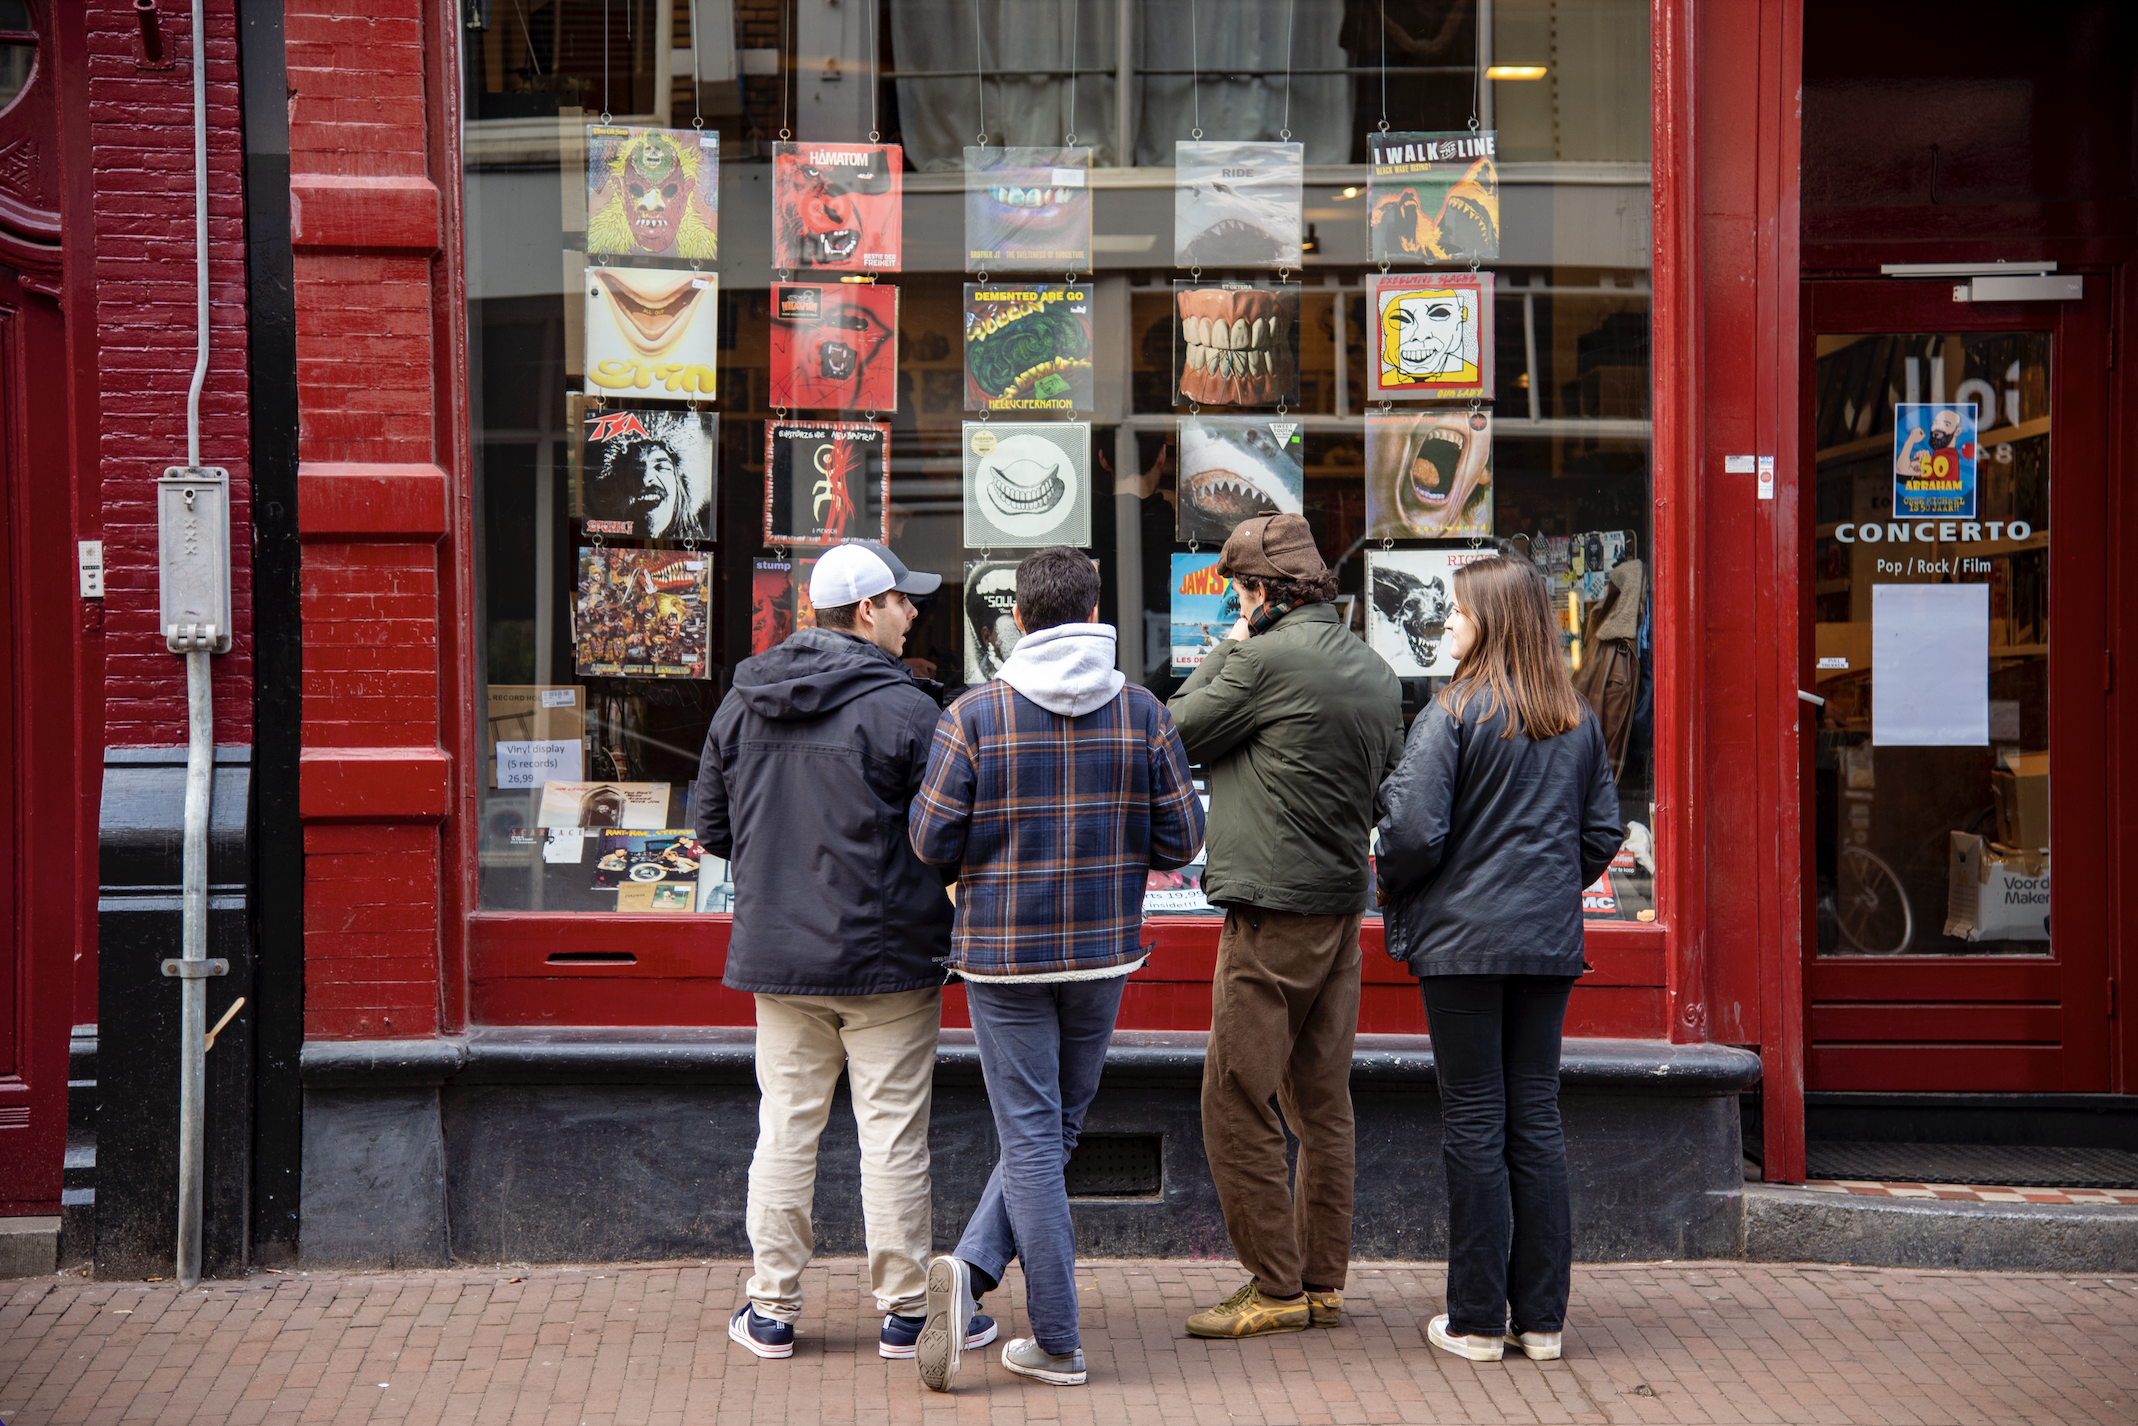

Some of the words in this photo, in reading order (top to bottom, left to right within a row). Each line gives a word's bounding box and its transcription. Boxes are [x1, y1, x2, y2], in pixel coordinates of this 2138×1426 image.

[1374, 148, 1381, 165] I
[1386, 142, 1440, 164] WALK
[1458, 137, 1495, 158] LINE
[1222, 168, 1254, 178] RIDE
[1376, 167, 1393, 175] BLACK
[1394, 164, 1409, 174] WAVE
[1410, 162, 1431, 172] RISING!
[970, 250, 993, 259] BROTHER
[1006, 250, 1015, 259] THE
[863, 259, 897, 267] FREIHEIT
[1380, 275, 1434, 285] EXECUTIVE
[1437, 273, 1477, 284] SLACKS
[974, 291, 1038, 301] DEMENTED
[1040, 291, 1064, 301] ARE
[1066, 292, 1084, 301] GO
[782, 301, 819, 313] HEAVEN
[587, 359, 716, 394] grin
[1457, 388, 1484, 398] LADY
[1410, 416, 1438, 424] WITHIN
[584, 411, 652, 443] TSA
[1921, 455, 1949, 478] 50
[1905, 480, 1963, 491] ABRAHAM
[1903, 497, 1925, 505] ONZE
[1926, 497, 1965, 505] MICHAEL
[1920, 504, 1931, 513] 50
[1932, 503, 1960, 512] JAAR!!
[1417, 524, 1486, 532] soulwound
[1835, 521, 2031, 543] CONCERTO
[756, 561, 791, 571] stump
[1878, 558, 1903, 576] Pop
[1918, 558, 1950, 573] Rock
[1963, 558, 1992, 573] Film
[1179, 562, 1225, 595] JAWS
[507, 744, 531, 754] Vinyl
[533, 744, 565, 755] display
[507, 759, 517, 770] (5
[519, 759, 558, 770] records)
[508, 774, 534, 785] 26,99
[511, 828, 583, 836] SCARFACE
[1165, 890, 1204, 900] 19,99
